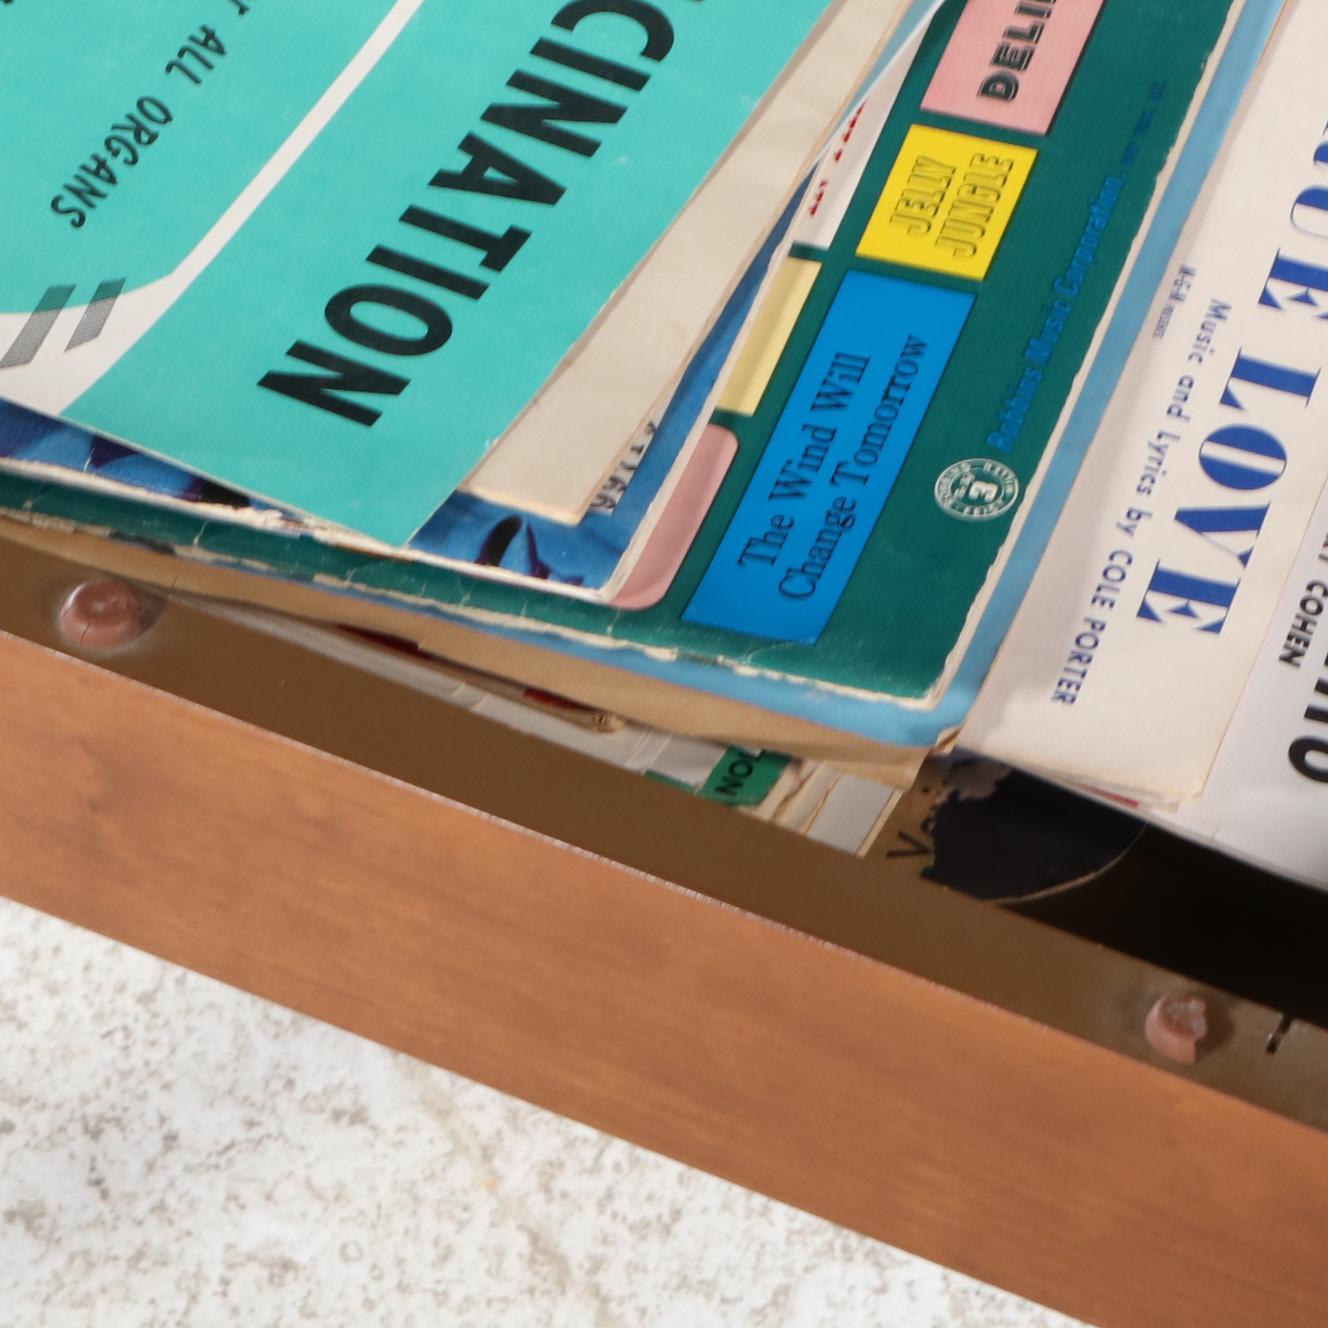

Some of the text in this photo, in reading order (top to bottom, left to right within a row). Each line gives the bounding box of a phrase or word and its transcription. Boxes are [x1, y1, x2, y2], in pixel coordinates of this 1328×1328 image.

[164, 25, 227, 85] ALL
[51, 96, 173, 228] ORGANS
[888, 155, 956, 236] JELLY
[935, 153, 1015, 260] JUNGLE
[986, 363, 1045, 452] Robbins
[1023, 297, 1073, 362] Music
[736, 351, 872, 569] The Wind Will
[778, 333, 928, 601] Change Tomorrow
[1053, 299, 1232, 705] Music and Lyrics by COLE PORTER
[1136, 347, 1322, 636] LOVE
